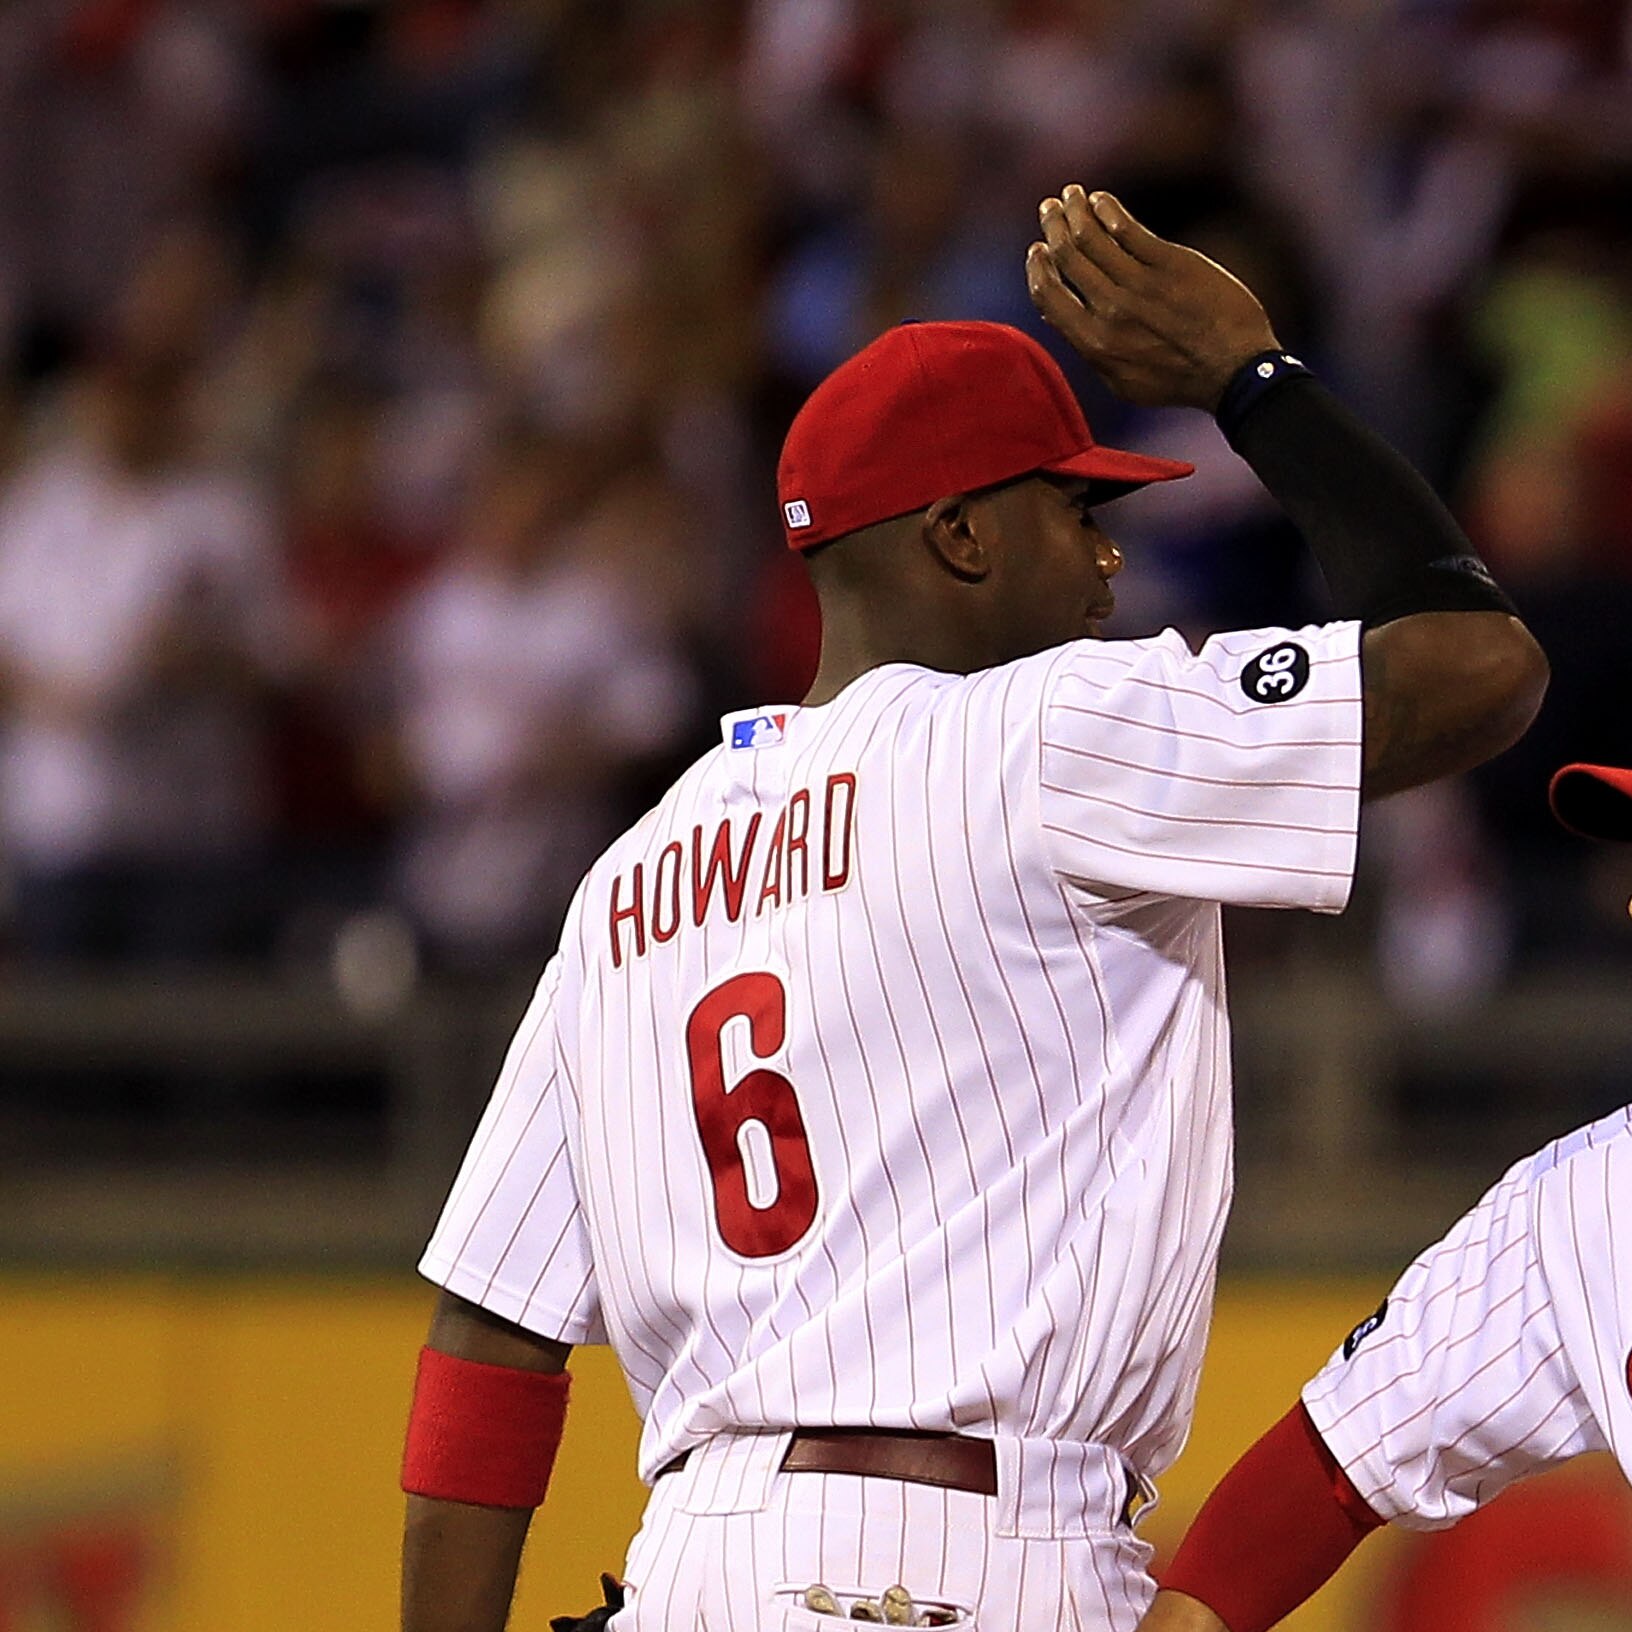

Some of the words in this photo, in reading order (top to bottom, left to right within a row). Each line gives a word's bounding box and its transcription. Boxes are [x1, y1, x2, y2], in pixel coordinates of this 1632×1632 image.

[1256, 647, 1294, 696] 36
[609, 772, 858, 970] HOWARD
[686, 970, 820, 1260] 6
